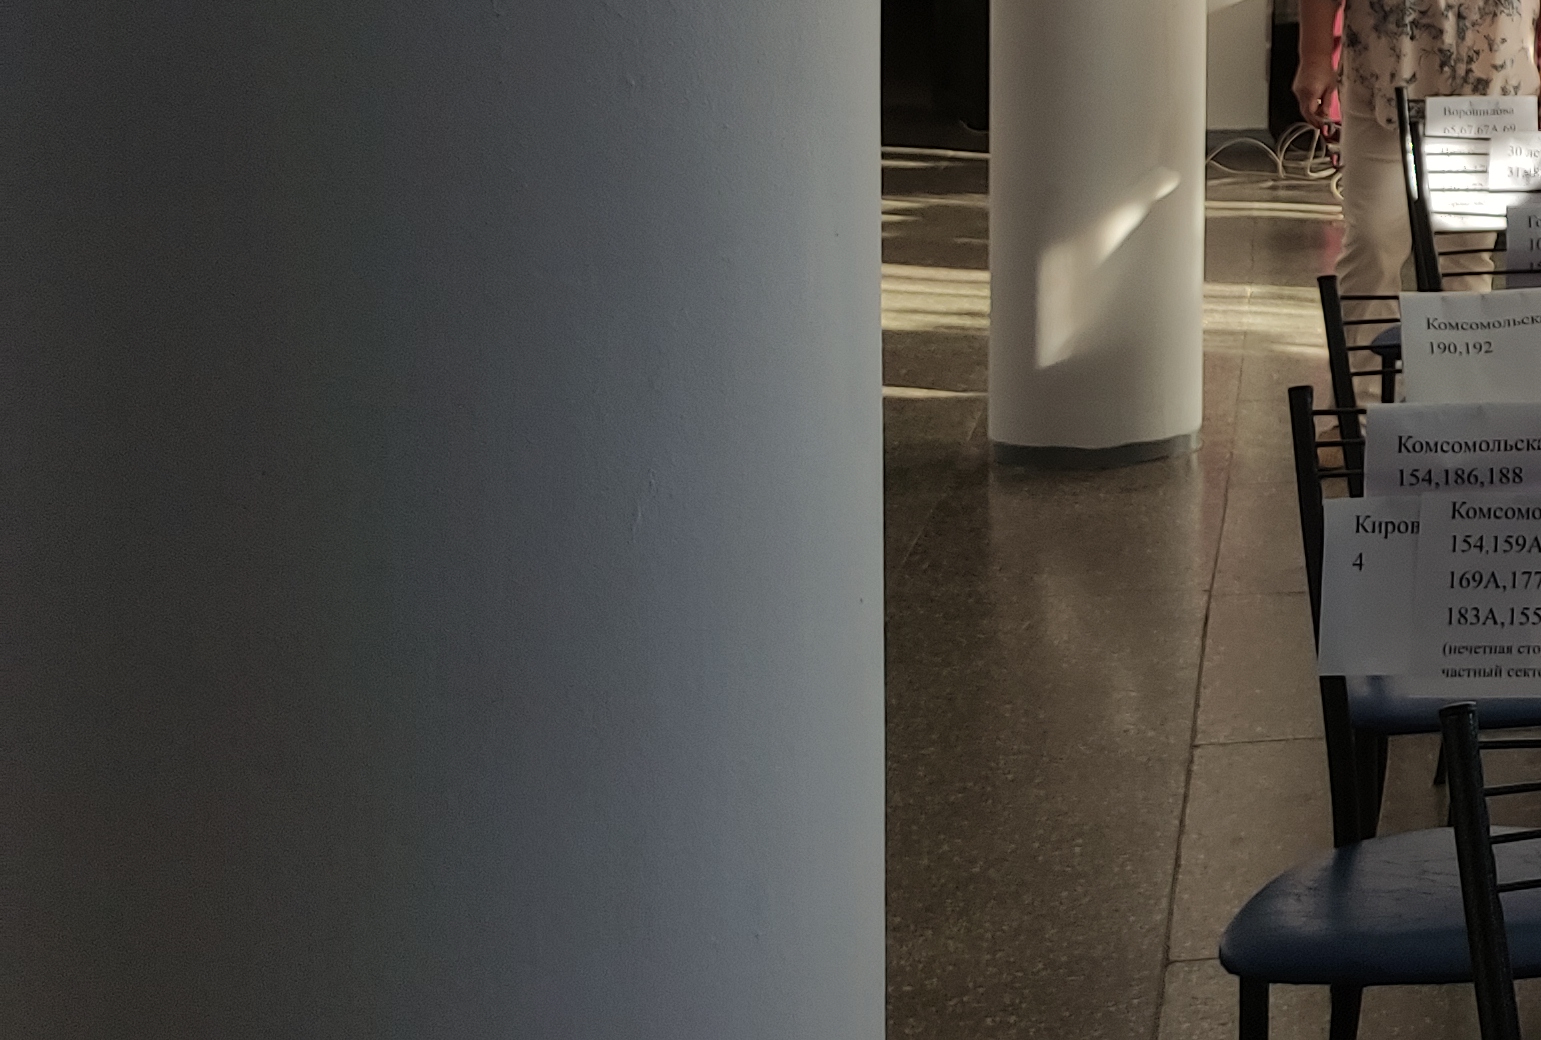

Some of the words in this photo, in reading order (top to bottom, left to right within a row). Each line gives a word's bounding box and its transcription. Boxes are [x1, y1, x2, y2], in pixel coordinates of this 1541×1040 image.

[1429, 340, 1494, 356] 190,192
[1399, 466, 1524, 488] 154,186,188
[1352, 552, 1364, 571] 4
[1442, 642, 1513, 656] (нечетная
[1441, 665, 1502, 679] частный
